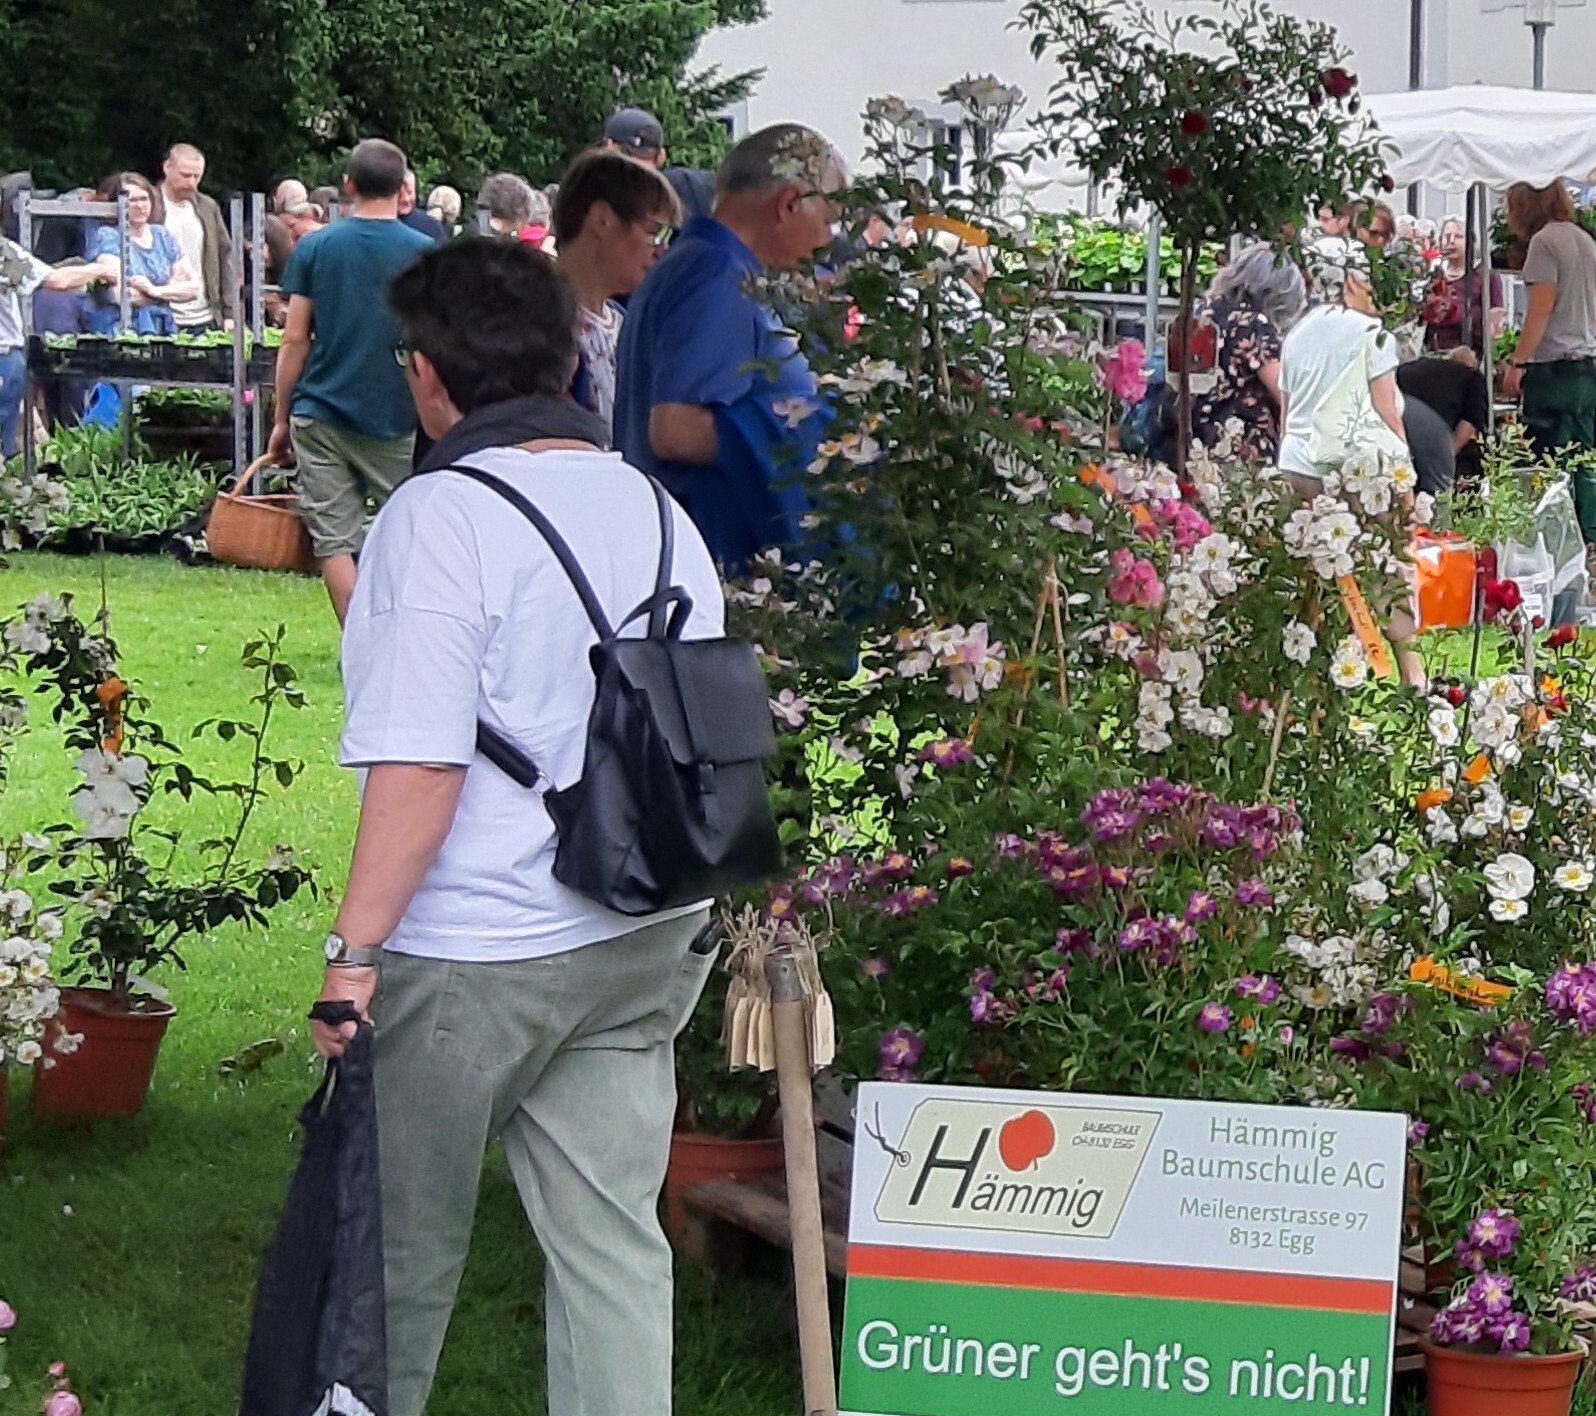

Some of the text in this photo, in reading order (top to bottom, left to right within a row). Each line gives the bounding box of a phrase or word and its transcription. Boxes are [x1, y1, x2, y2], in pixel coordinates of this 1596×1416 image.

[1208, 1116, 1338, 1157] Hämmig
[907, 1123, 1104, 1229] Hämmig
[1161, 1148, 1387, 1190] Baumschule AG
[1179, 1196, 1369, 1233] Meilenerstrasse 97
[1228, 1229, 1316, 1255] 8132 Egg
[856, 1319, 1372, 1406] Grüner geht's nicht!
